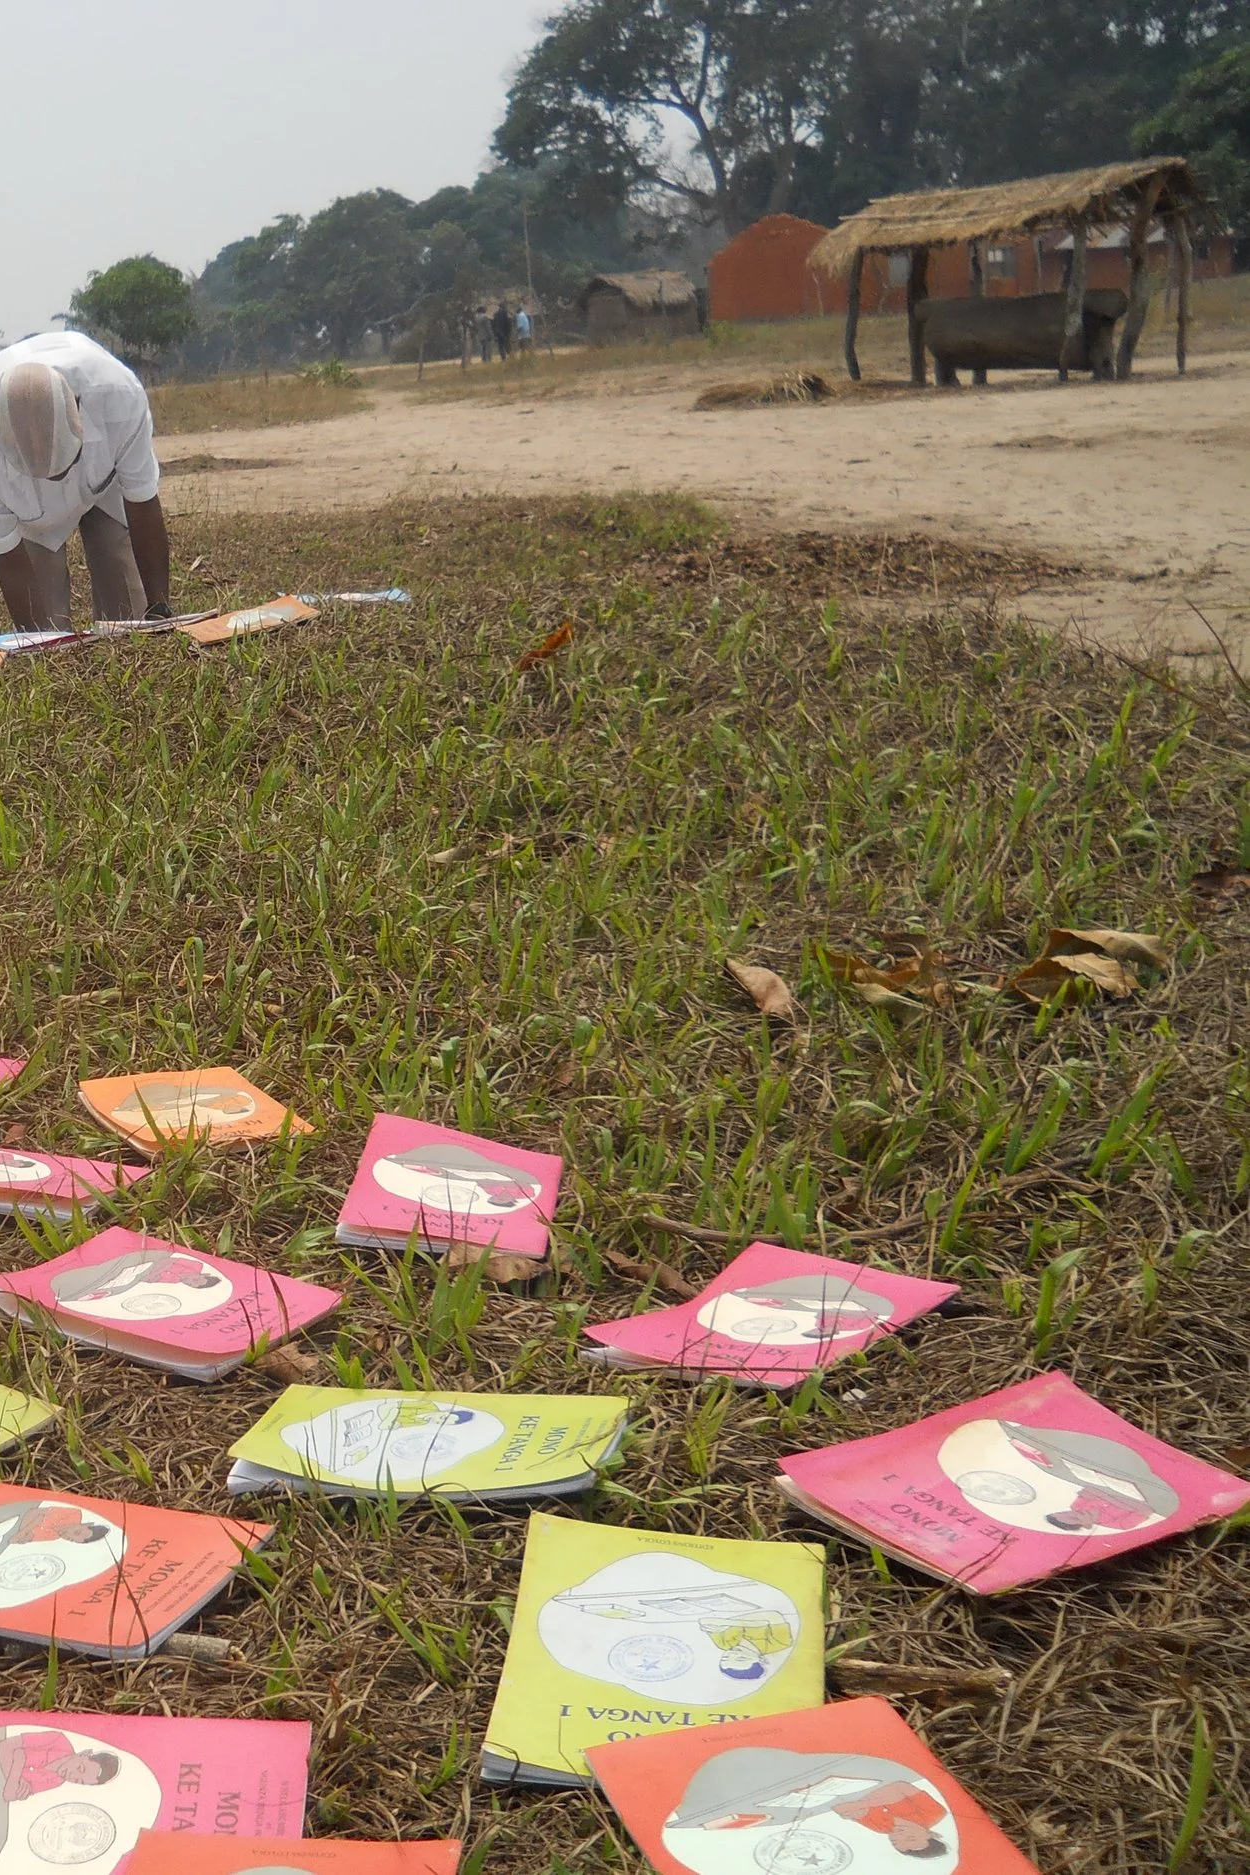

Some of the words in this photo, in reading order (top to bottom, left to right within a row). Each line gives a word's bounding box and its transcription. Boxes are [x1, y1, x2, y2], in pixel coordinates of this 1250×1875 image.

[518, 1416, 540, 1429] KE
[499, 1431, 533, 1464] TANGA
[538, 1427, 569, 1455] MONO
[903, 1484, 978, 1527] TANGA
[890, 1503, 965, 1543] MONO
[978, 1525, 1019, 1545] KE
[137, 1538, 168, 1559] KE
[560, 1704, 573, 1717] 1
[586, 1706, 697, 1726] TANGA
[177, 1762, 202, 1794] KE
[214, 1791, 241, 1835] MO
